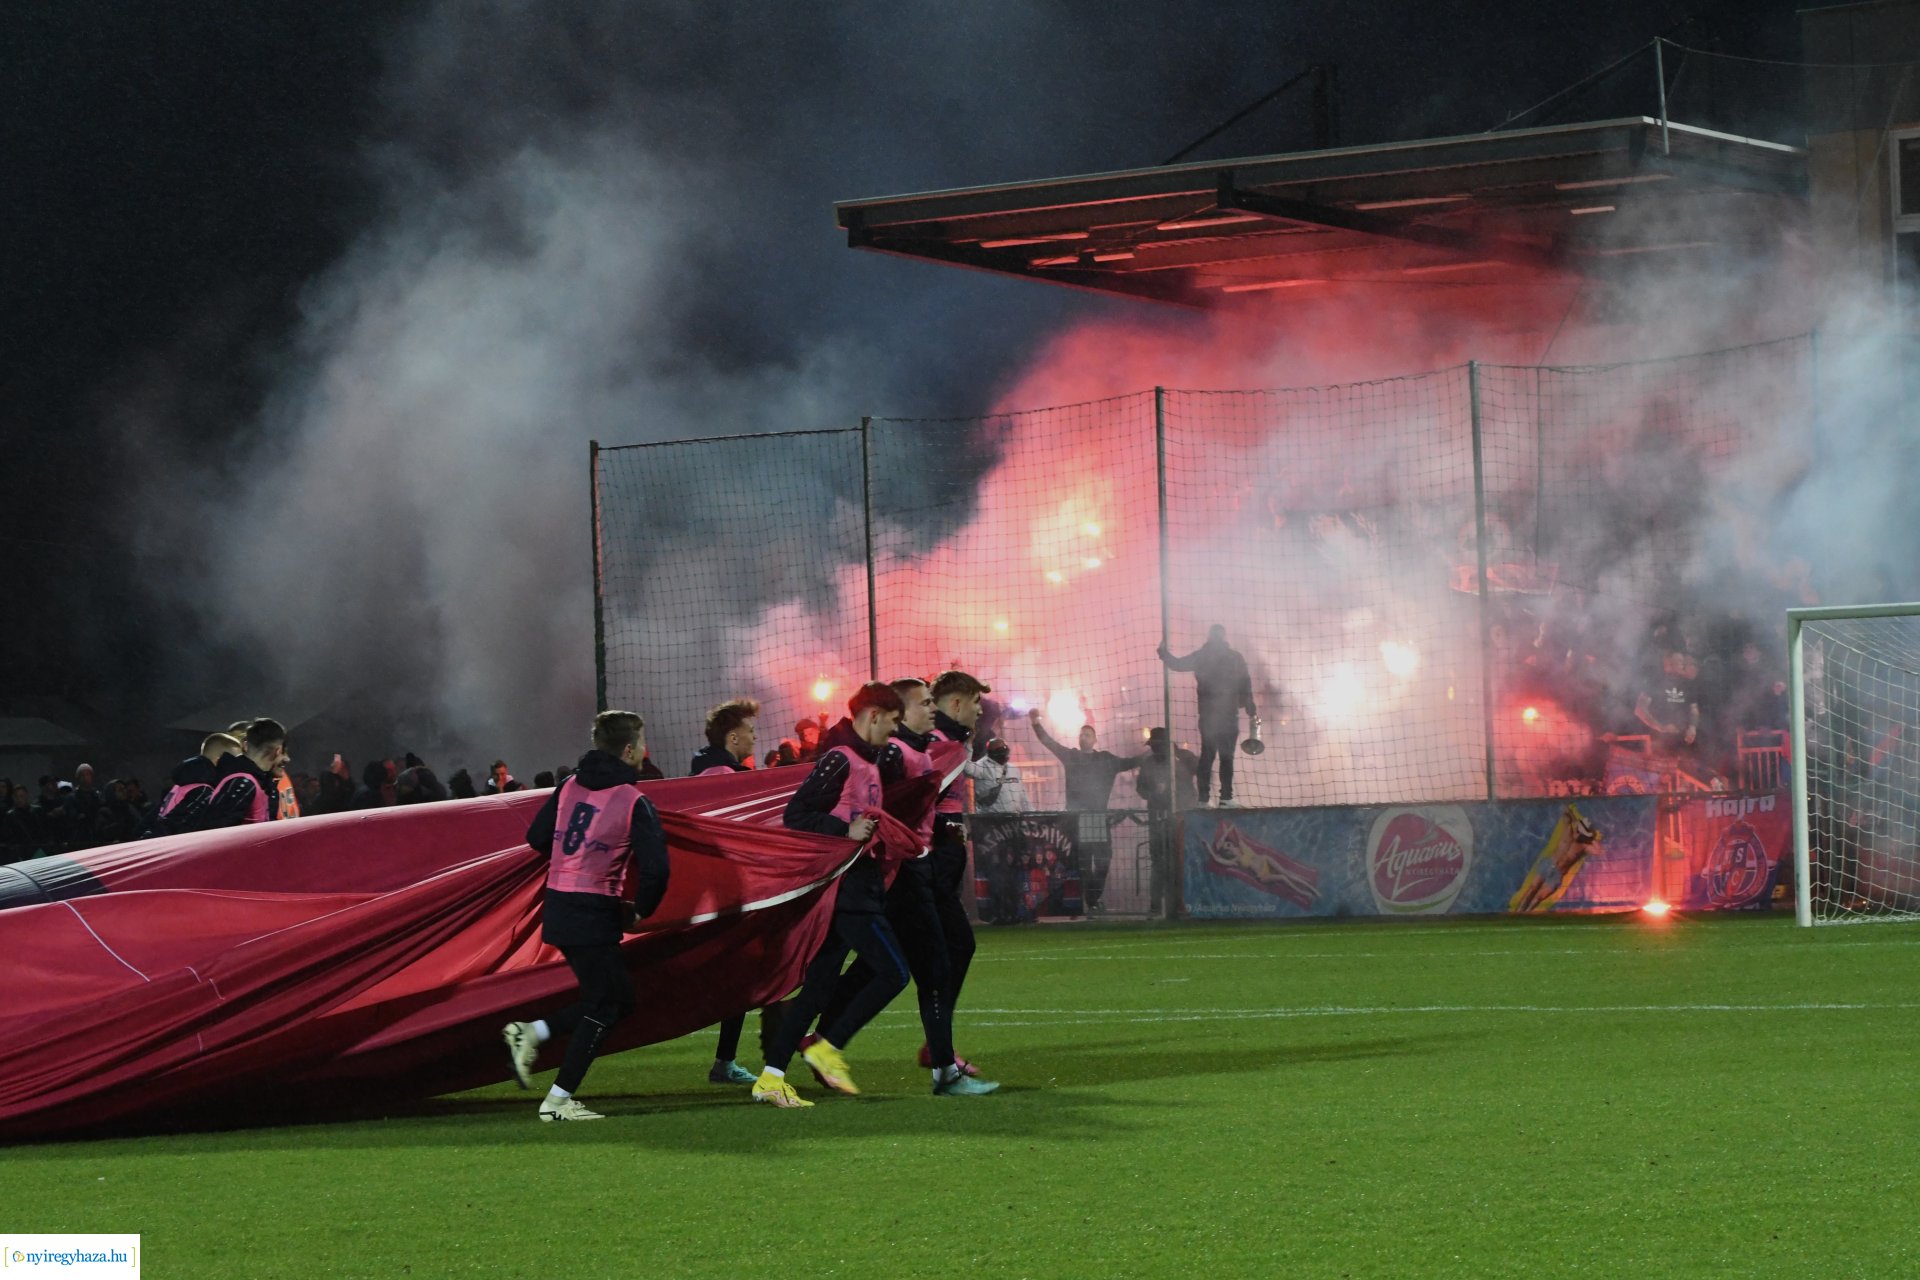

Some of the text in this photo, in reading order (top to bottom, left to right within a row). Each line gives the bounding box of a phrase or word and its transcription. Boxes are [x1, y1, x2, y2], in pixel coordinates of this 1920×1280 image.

[563, 802, 595, 855] 8
[1705, 796, 1776, 820] Hajra
[1373, 834, 1463, 902] Aquarius
